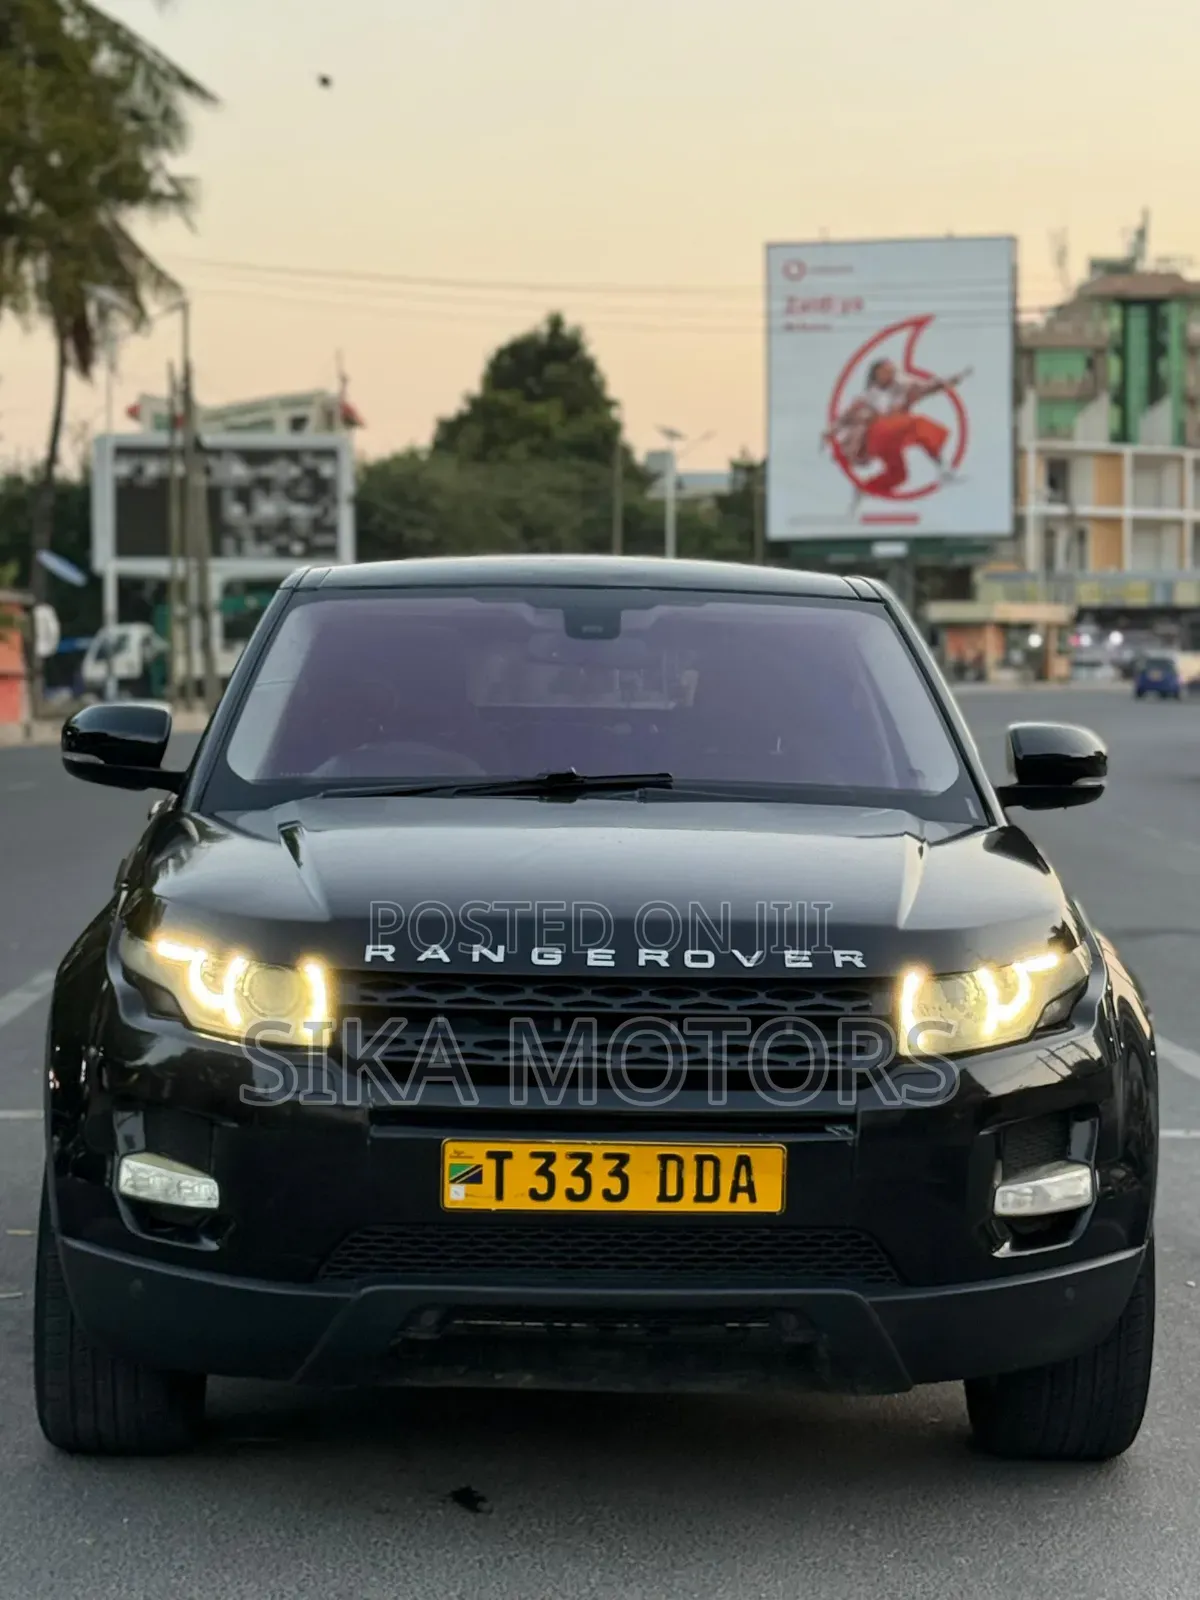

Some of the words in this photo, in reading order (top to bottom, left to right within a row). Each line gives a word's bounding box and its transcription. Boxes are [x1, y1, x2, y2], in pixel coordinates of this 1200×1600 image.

[364, 944, 616, 967] RANGE
[637, 948, 868, 970] ROVER
[485, 1150, 514, 1203] T
[528, 1151, 631, 1204] 333
[655, 1152, 758, 1205] DDA
